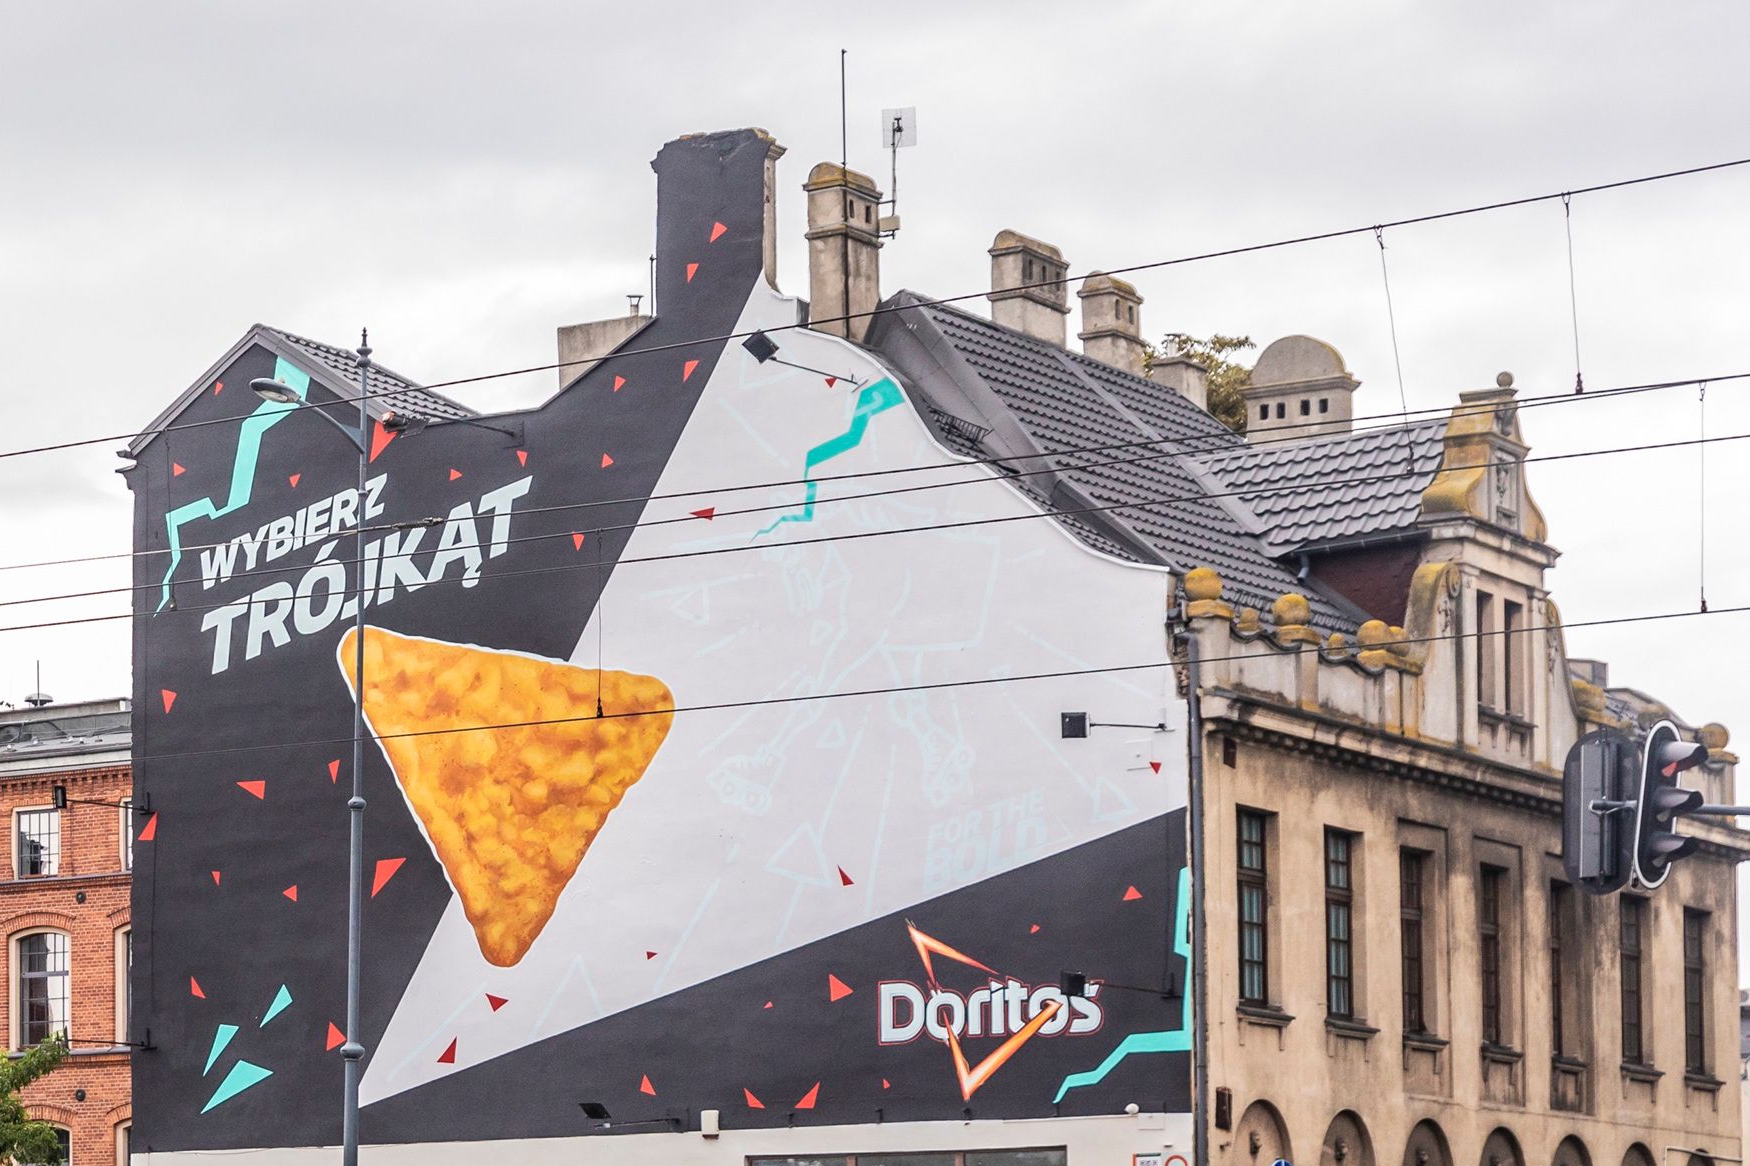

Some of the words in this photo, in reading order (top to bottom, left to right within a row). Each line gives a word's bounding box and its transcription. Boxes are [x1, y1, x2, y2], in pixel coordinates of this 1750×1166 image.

[200, 473, 388, 591] WYBIERZ
[201, 475, 533, 675] TRÓJKĄT
[922, 816, 1048, 894] BOLD
[879, 978, 1103, 1045] Doritos
